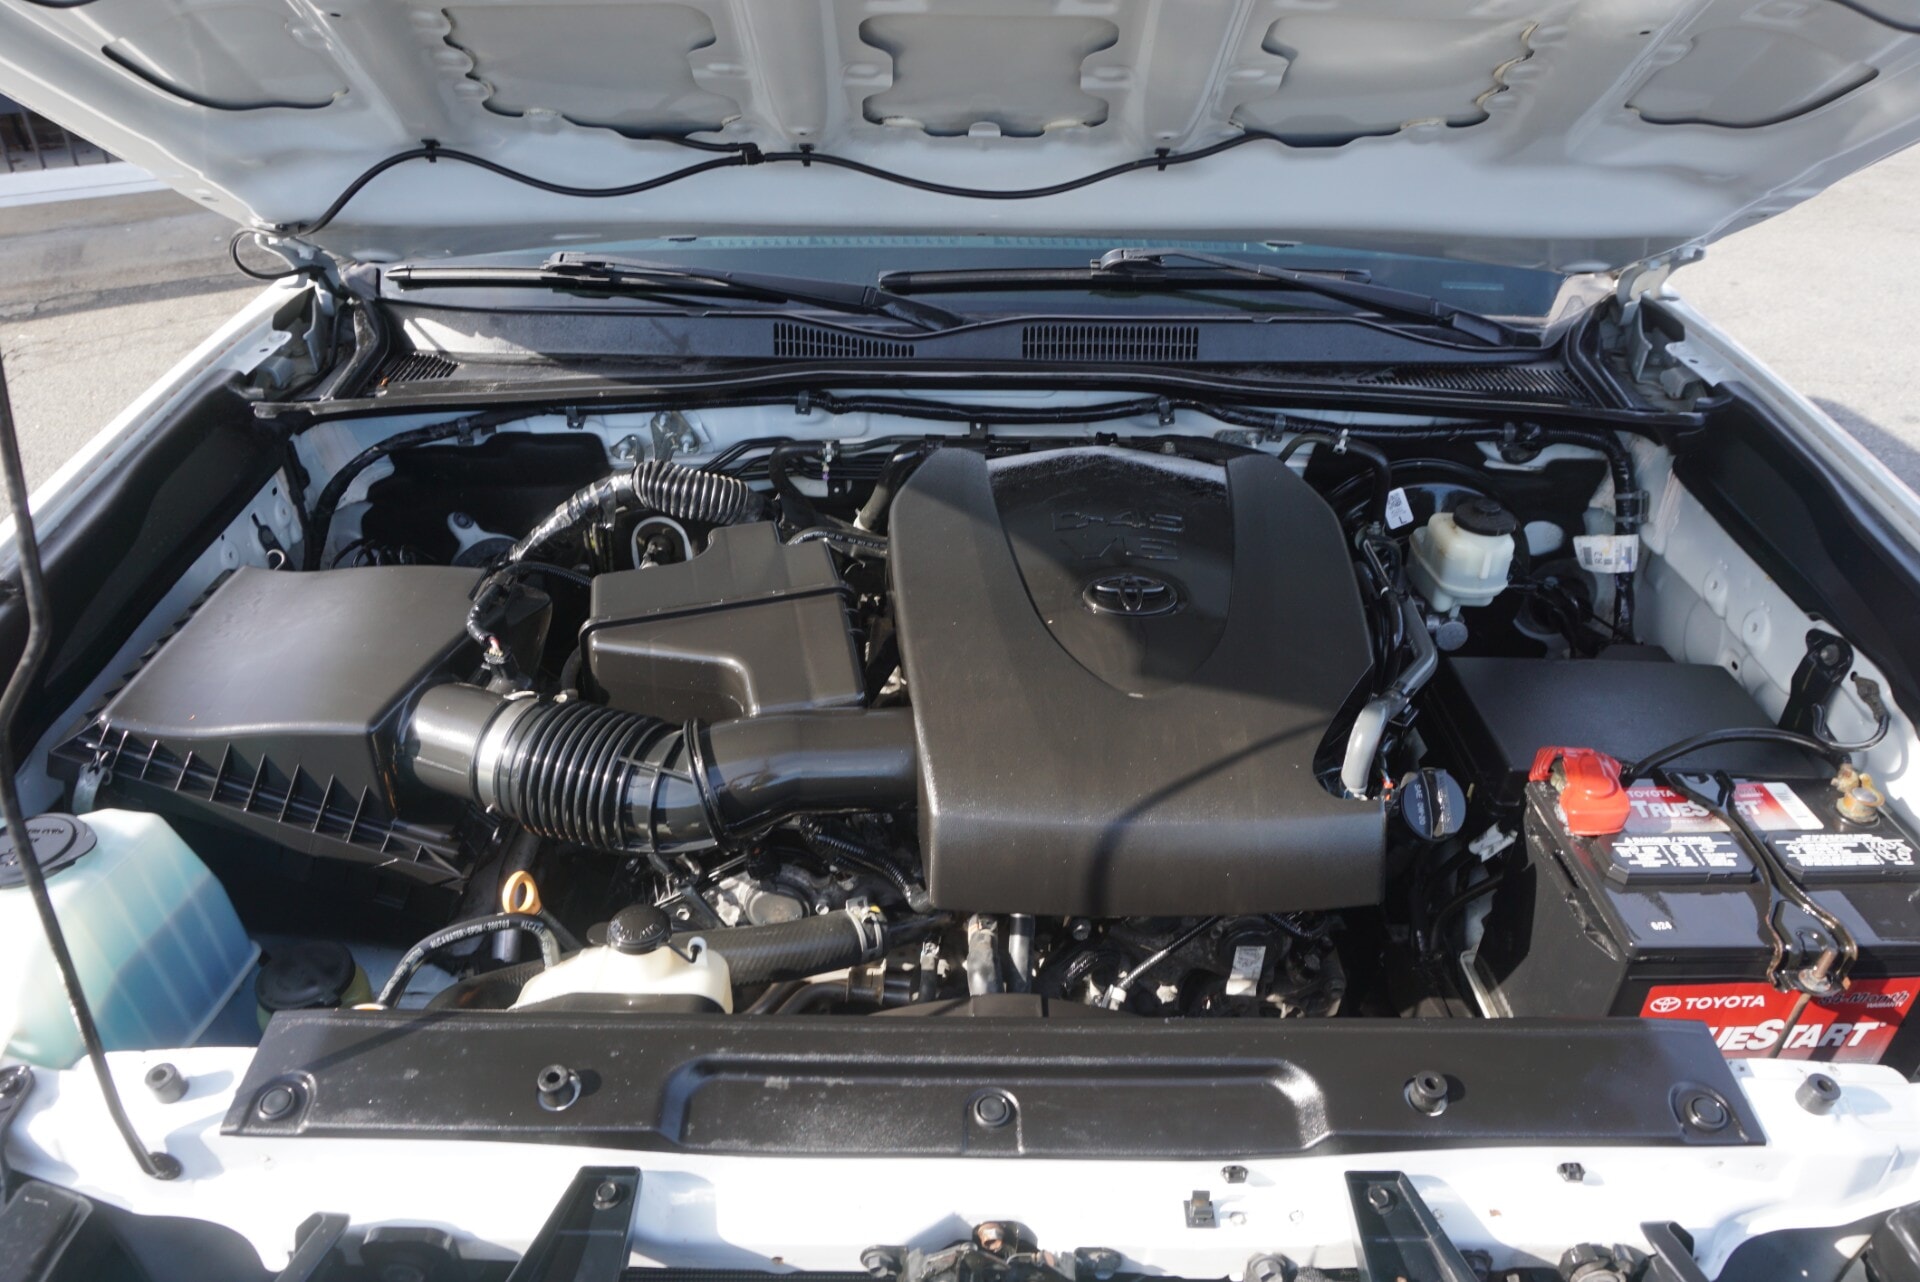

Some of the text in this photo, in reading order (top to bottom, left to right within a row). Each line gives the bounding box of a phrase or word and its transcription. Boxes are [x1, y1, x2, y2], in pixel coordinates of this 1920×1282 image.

[1627, 789, 1677, 799] TOYOTA
[1685, 995, 1765, 1010] TOYOTA
[1709, 1019, 1880, 1050] UESTART
